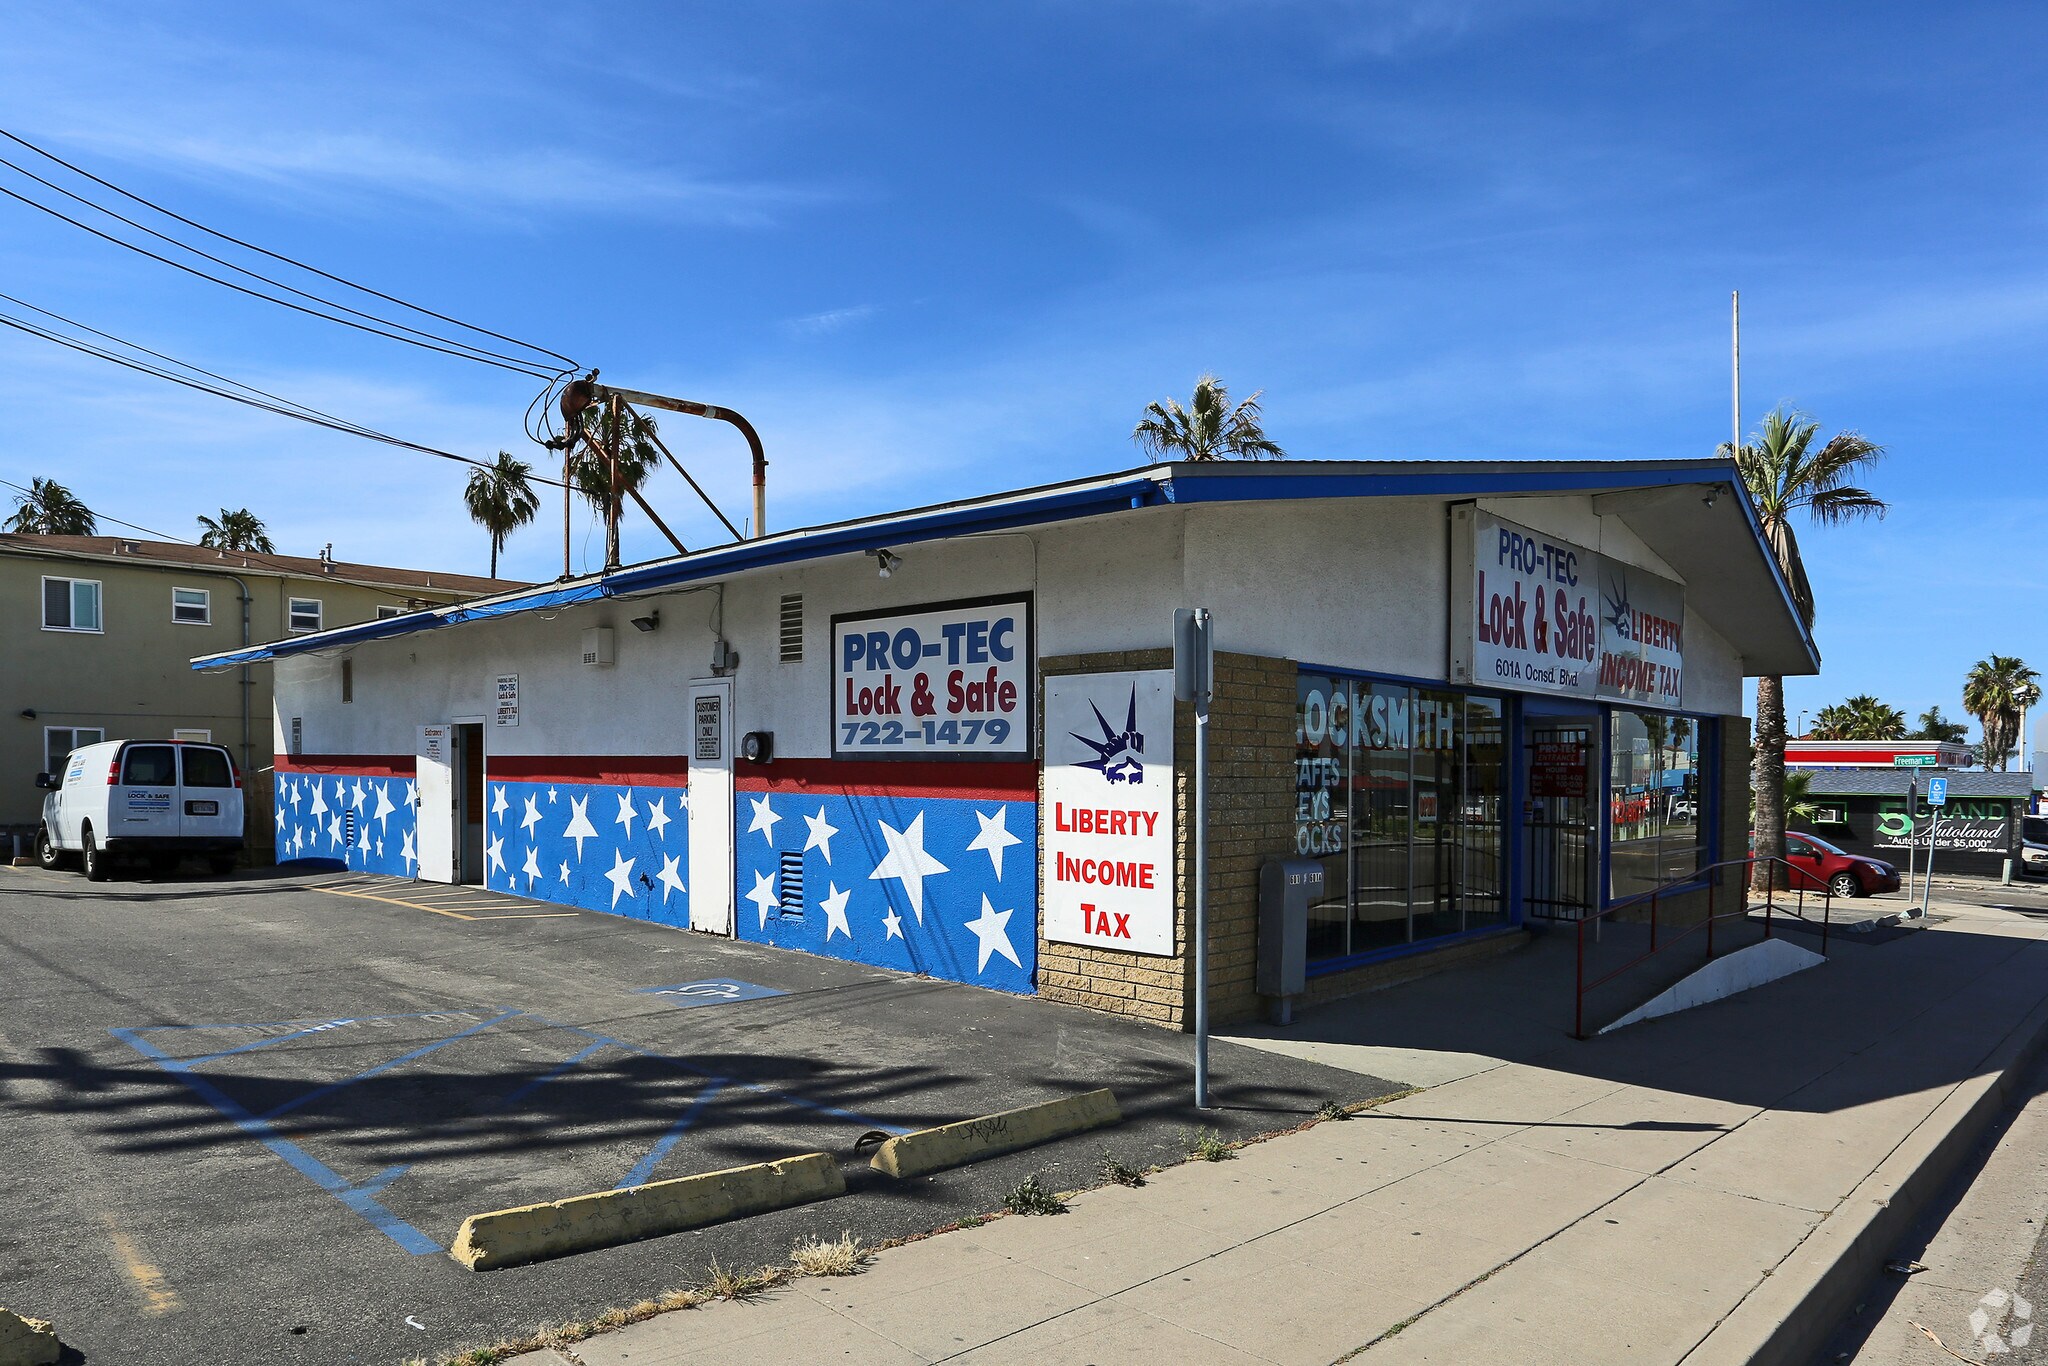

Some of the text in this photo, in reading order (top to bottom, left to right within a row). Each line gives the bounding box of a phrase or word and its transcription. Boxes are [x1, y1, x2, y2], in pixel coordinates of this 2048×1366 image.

[1499, 528, 1578, 587] PRO-TEC
[1478, 570, 1595, 662] Lock & Safe
[1631, 609, 1681, 653] LIBERTY
[843, 617, 1014, 672] PRO-TEC
[498, 683, 516, 691] PRO-TEC
[1495, 658, 1579, 687] 601A Ocnsd. Blvd.
[1600, 652, 1680, 698] INCOME TAX
[846, 666, 1017, 717] Lock & Safe
[697, 701, 720, 713] CUSTOMER
[698, 714, 717, 725] PARKING
[424, 727, 443, 736] Entrance
[702, 726, 713, 737] ONLY
[841, 718, 1011, 745] 722-1479
[1539, 744, 1577, 753] PRO-TEC
[1894, 756, 1923, 765] Freeman
[1296, 757, 1340, 787] AFES
[1055, 802, 1159, 837] LIBERTY
[1296, 790, 1330, 821] EYS
[1296, 824, 1342, 855] OCKS
[1914, 819, 2006, 839] Autoland
[1921, 837, 1952, 847] Uder
[1056, 851, 1155, 890] INCOME
[1080, 903, 1131, 939] TAX
